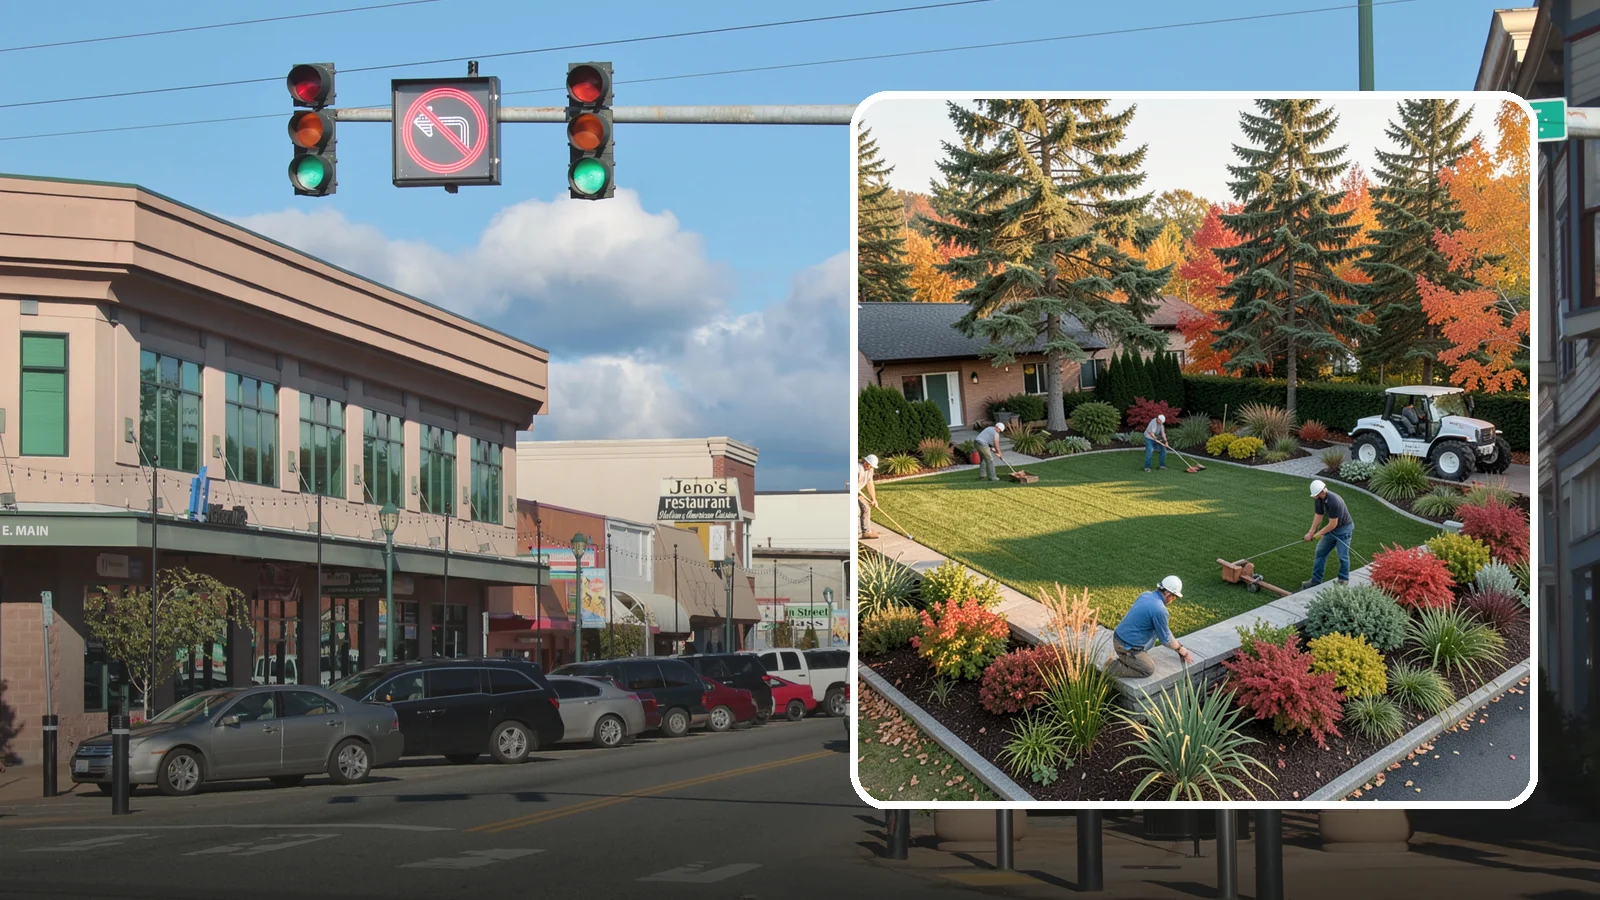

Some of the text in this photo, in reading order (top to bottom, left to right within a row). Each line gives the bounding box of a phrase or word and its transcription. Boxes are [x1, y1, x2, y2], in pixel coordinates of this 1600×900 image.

[670, 480, 727, 494] Jeno's
[665, 496, 731, 509] restaurant
[686, 510, 715, 519] American
[715, 509, 737, 519] Cuisine
[2, 525, 49, 536] E. MAIN
[797, 607, 828, 616] Street
